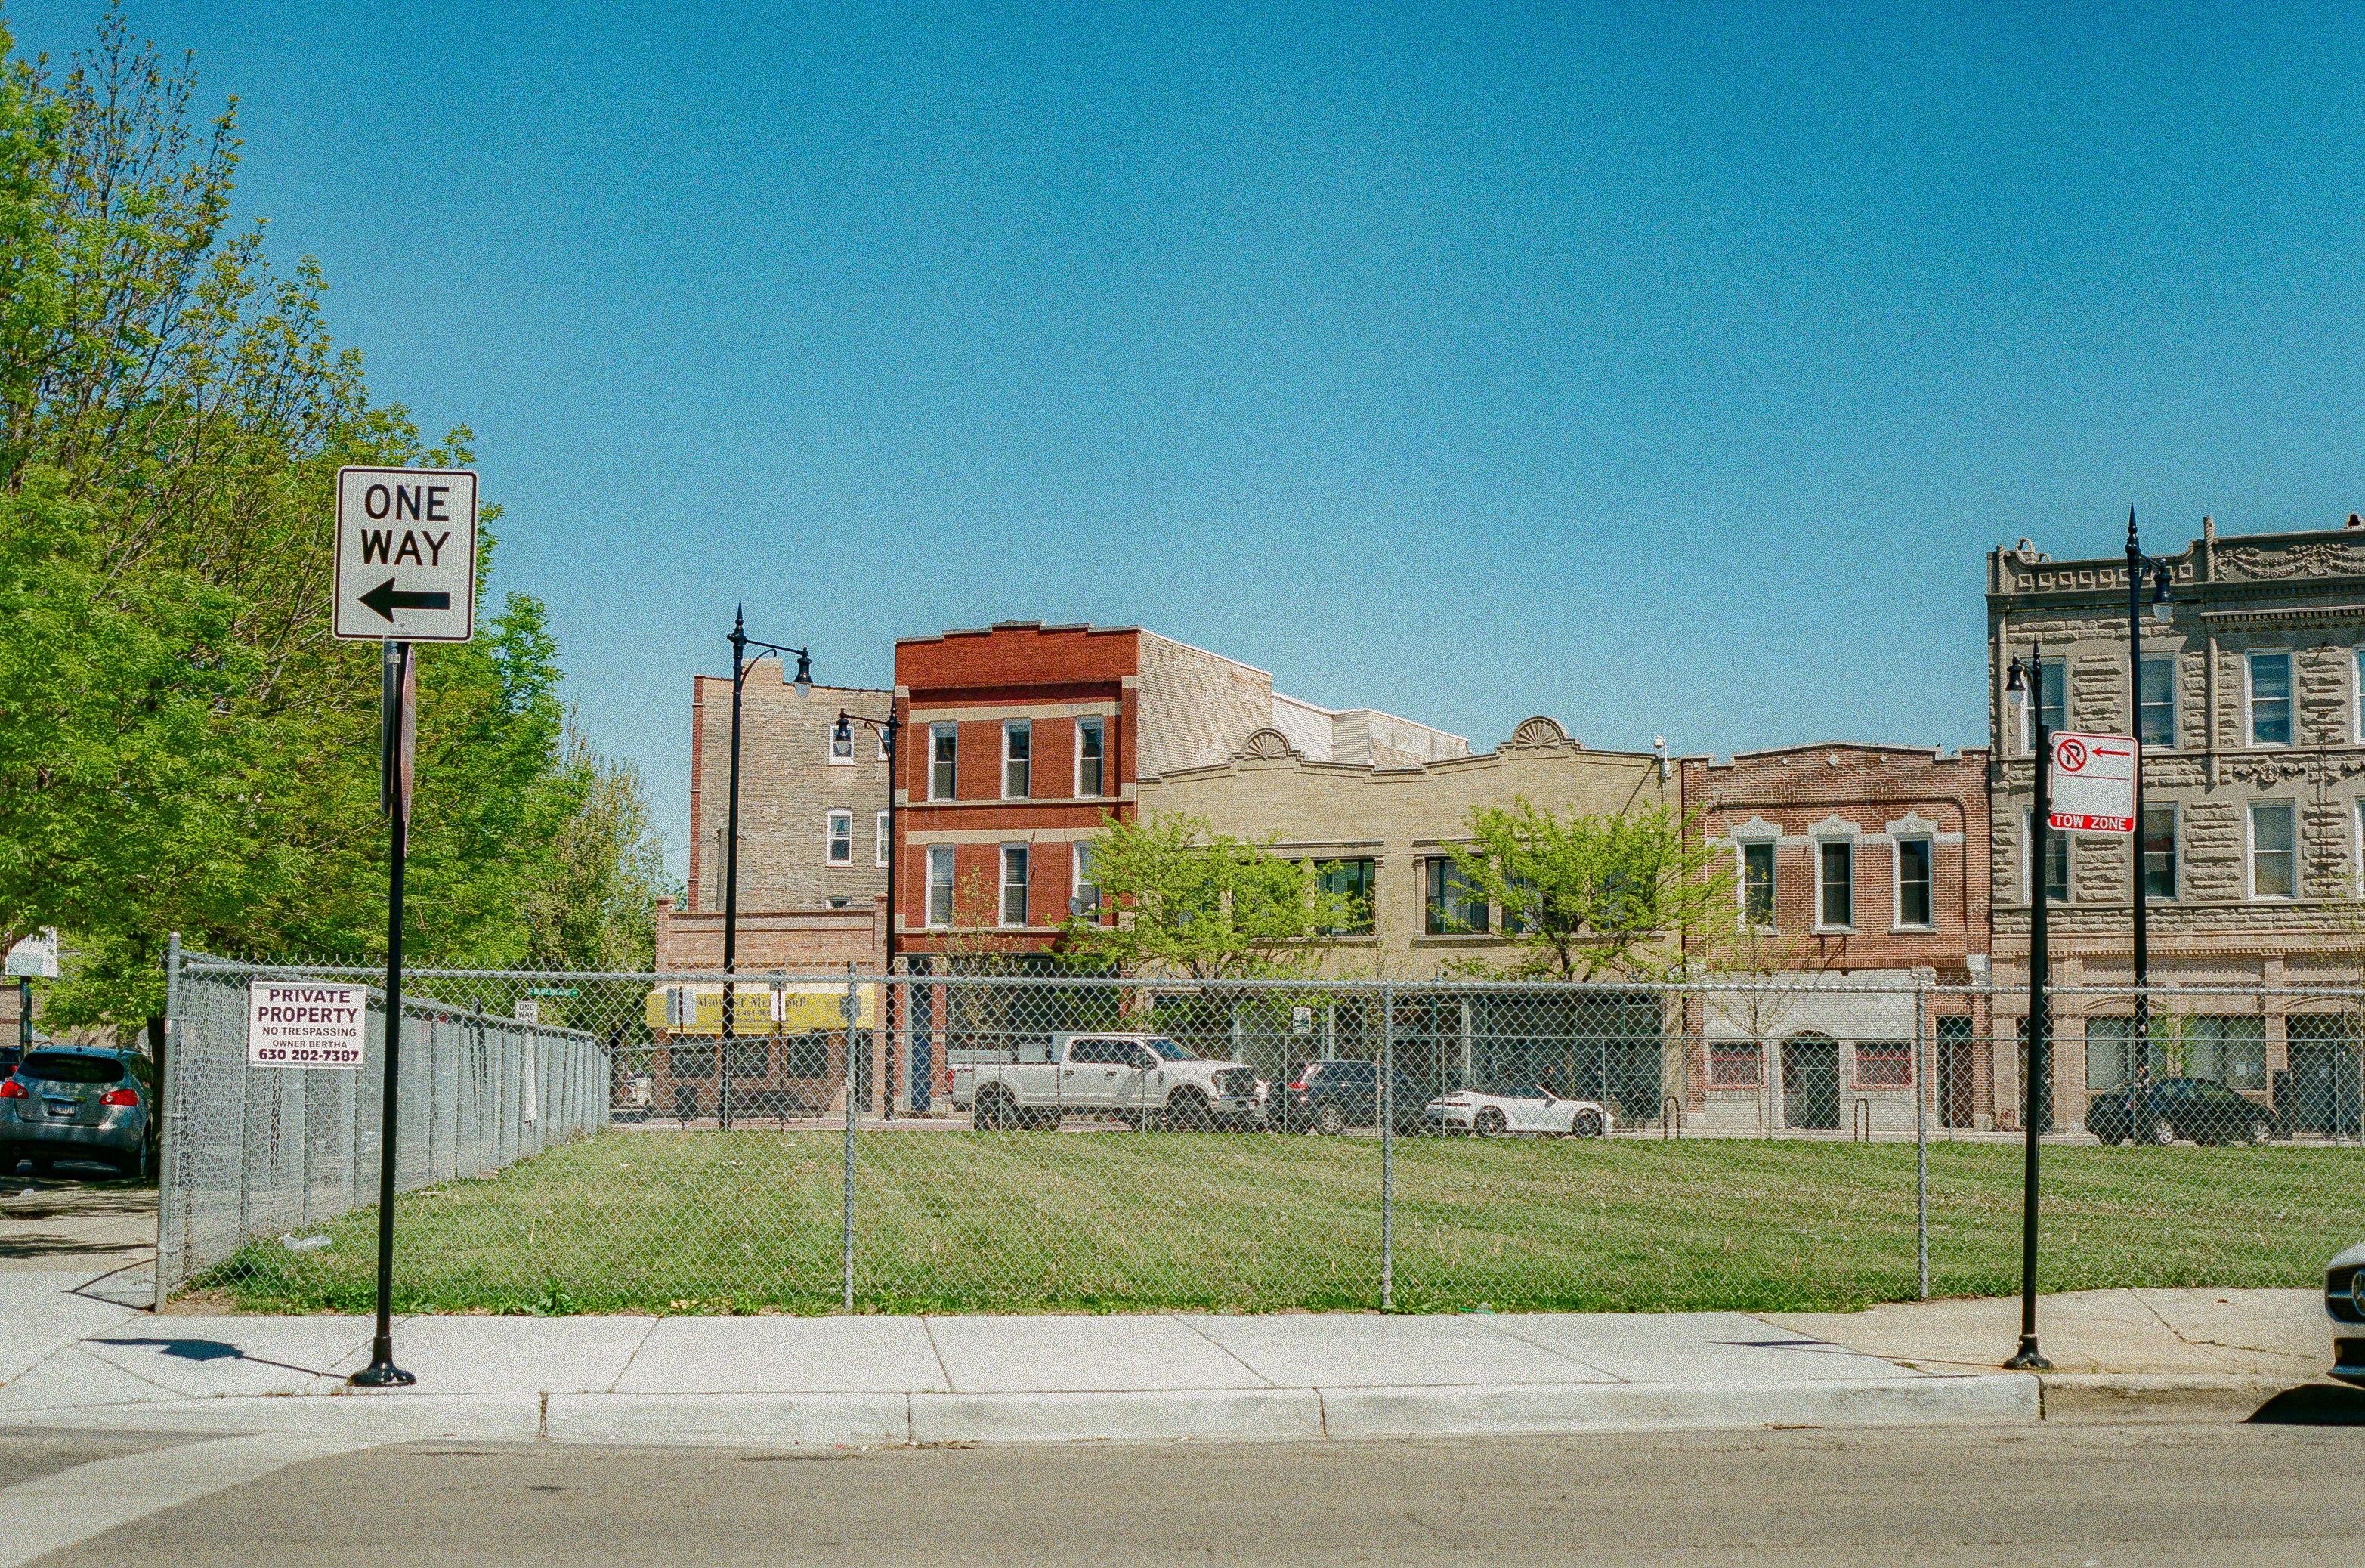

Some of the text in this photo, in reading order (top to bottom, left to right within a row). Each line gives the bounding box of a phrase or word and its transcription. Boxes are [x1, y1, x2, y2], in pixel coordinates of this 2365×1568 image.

[364, 484, 450, 521] ONE
[360, 529, 451, 567] WAY
[2054, 815, 2127, 830] TOW ZONE
[269, 988, 351, 1003] PRIVATE
[258, 1006, 358, 1023] PROPERTY
[262, 1026, 357, 1037] NO TRESPASSING
[309, 1040, 348, 1048] BERTHA
[258, 1048, 360, 1062] 630 202-7387
